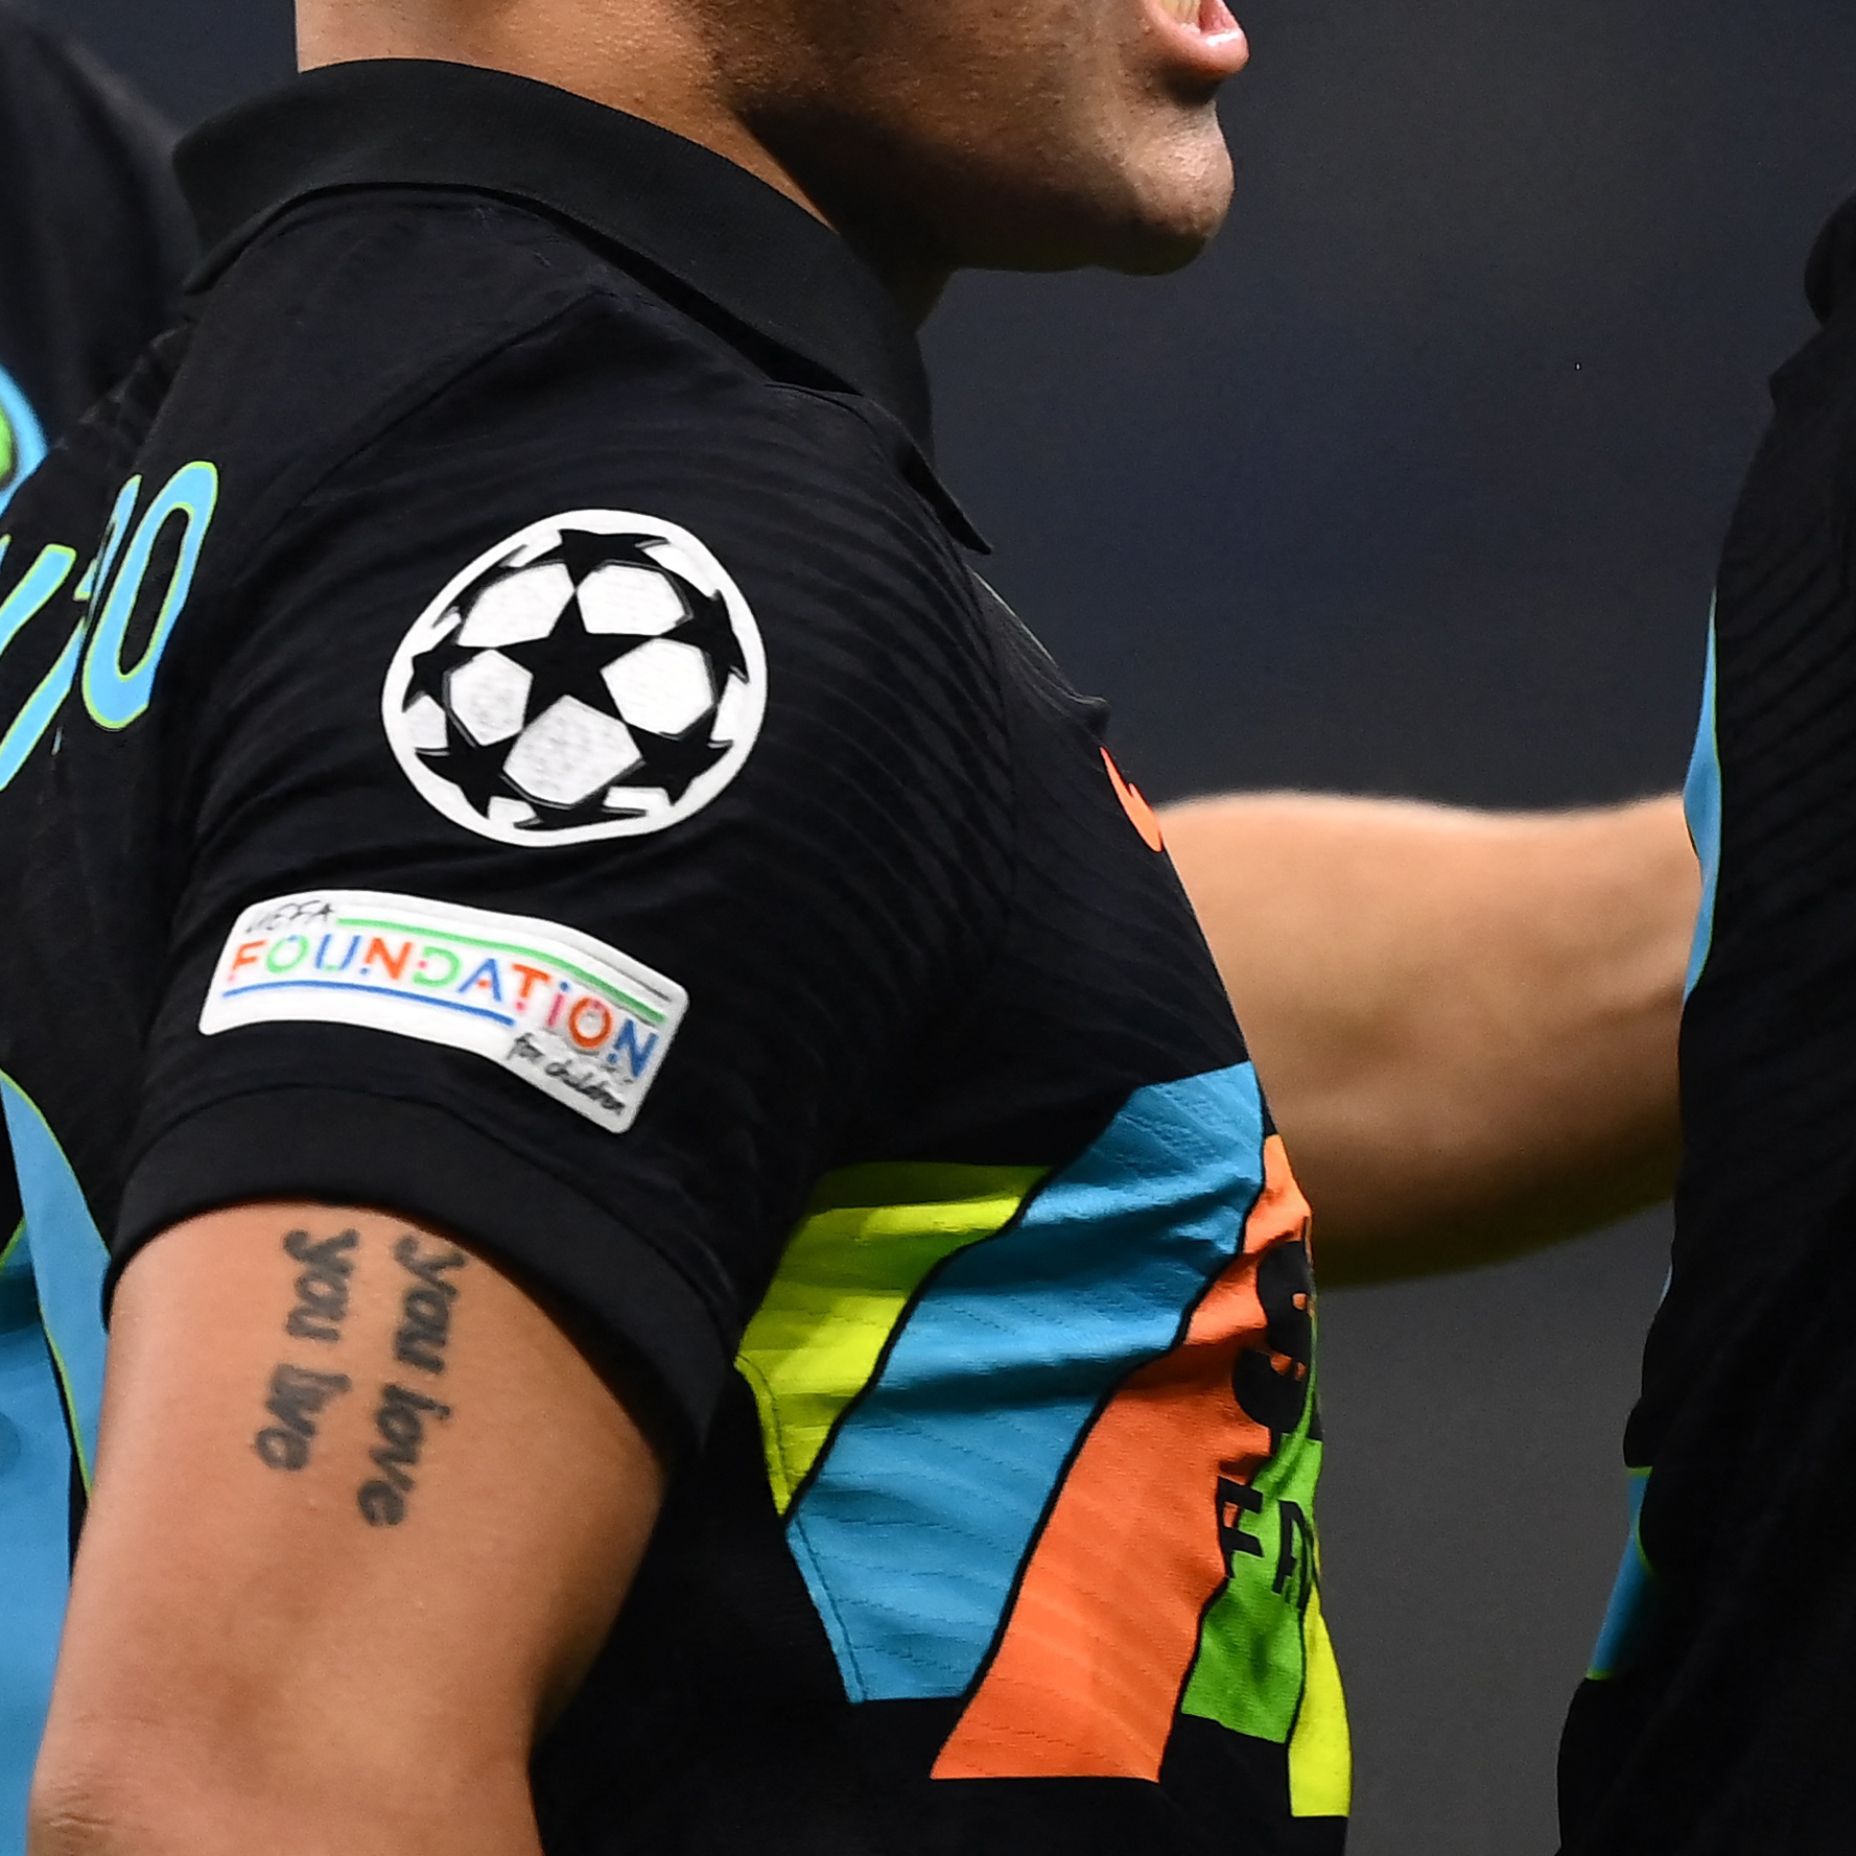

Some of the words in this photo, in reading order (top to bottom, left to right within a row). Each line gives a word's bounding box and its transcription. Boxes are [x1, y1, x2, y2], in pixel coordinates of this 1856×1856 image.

[282, 1228, 360, 1342] you
[392, 1236, 466, 1374] you
[356, 1381, 450, 1527] love
